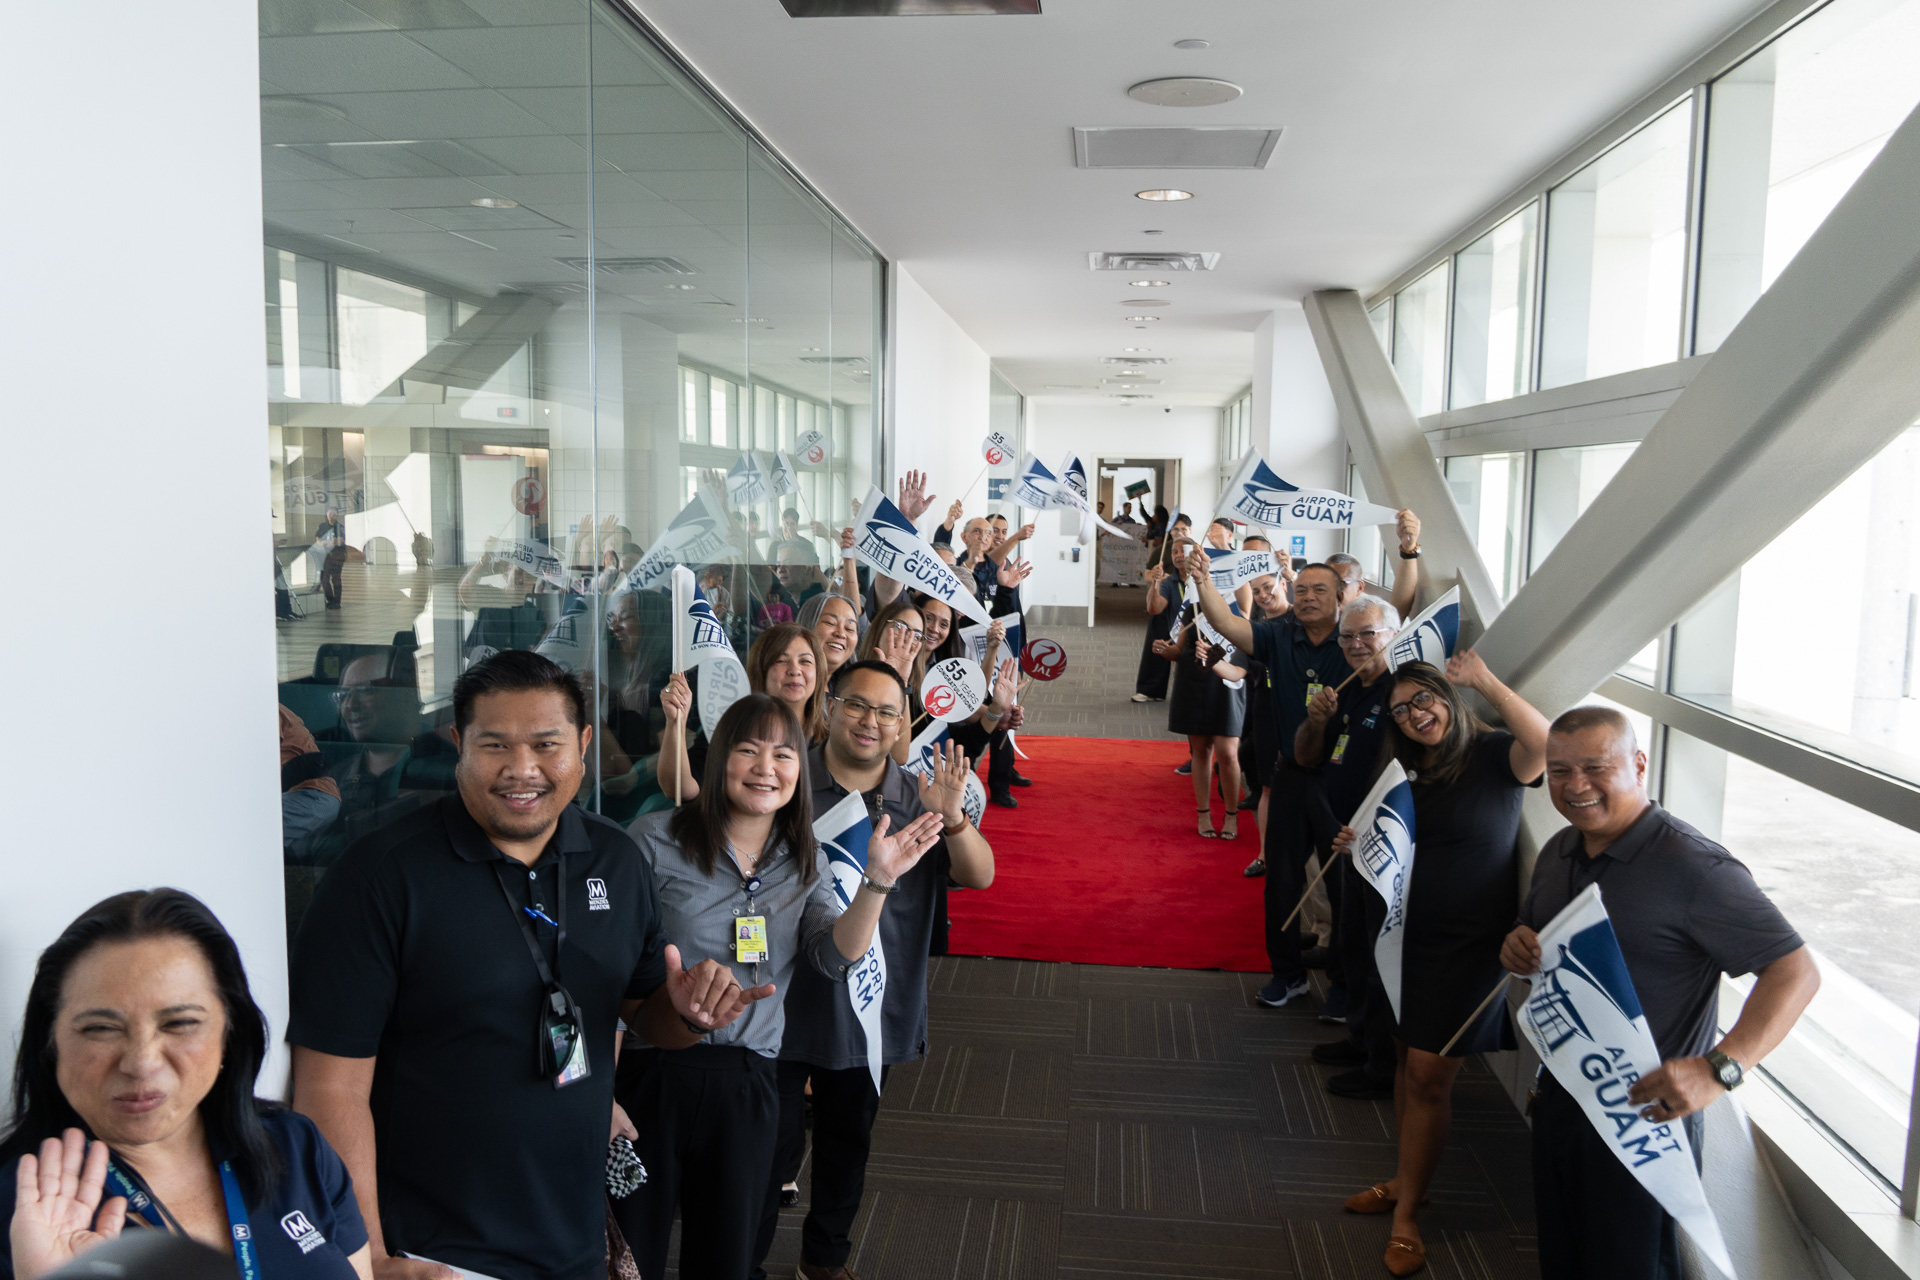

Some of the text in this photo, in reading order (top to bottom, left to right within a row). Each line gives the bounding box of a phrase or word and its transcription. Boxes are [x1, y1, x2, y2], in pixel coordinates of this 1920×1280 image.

[991, 431, 1005, 444] 55
[1295, 496, 1355, 510] AIRPORT
[1291, 504, 1354, 526] GUAM
[910, 549, 961, 588] AIRPORT
[1237, 553, 1270, 566] AIRPORT
[1237, 561, 1270, 577] GUAM
[903, 558, 956, 601] GUAM
[1032, 663, 1051, 677] JAL
[936, 664, 975, 713] CONGRATULATIONS
[945, 659, 980, 705] 55 YEARS
[927, 701, 940, 715] JAL
[590, 882, 605, 897] M
[866, 946, 883, 994] PORT
[855, 957, 874, 1012] AM
[1579, 1052, 1663, 1169] GUAM
[288, 1216, 311, 1236] M
